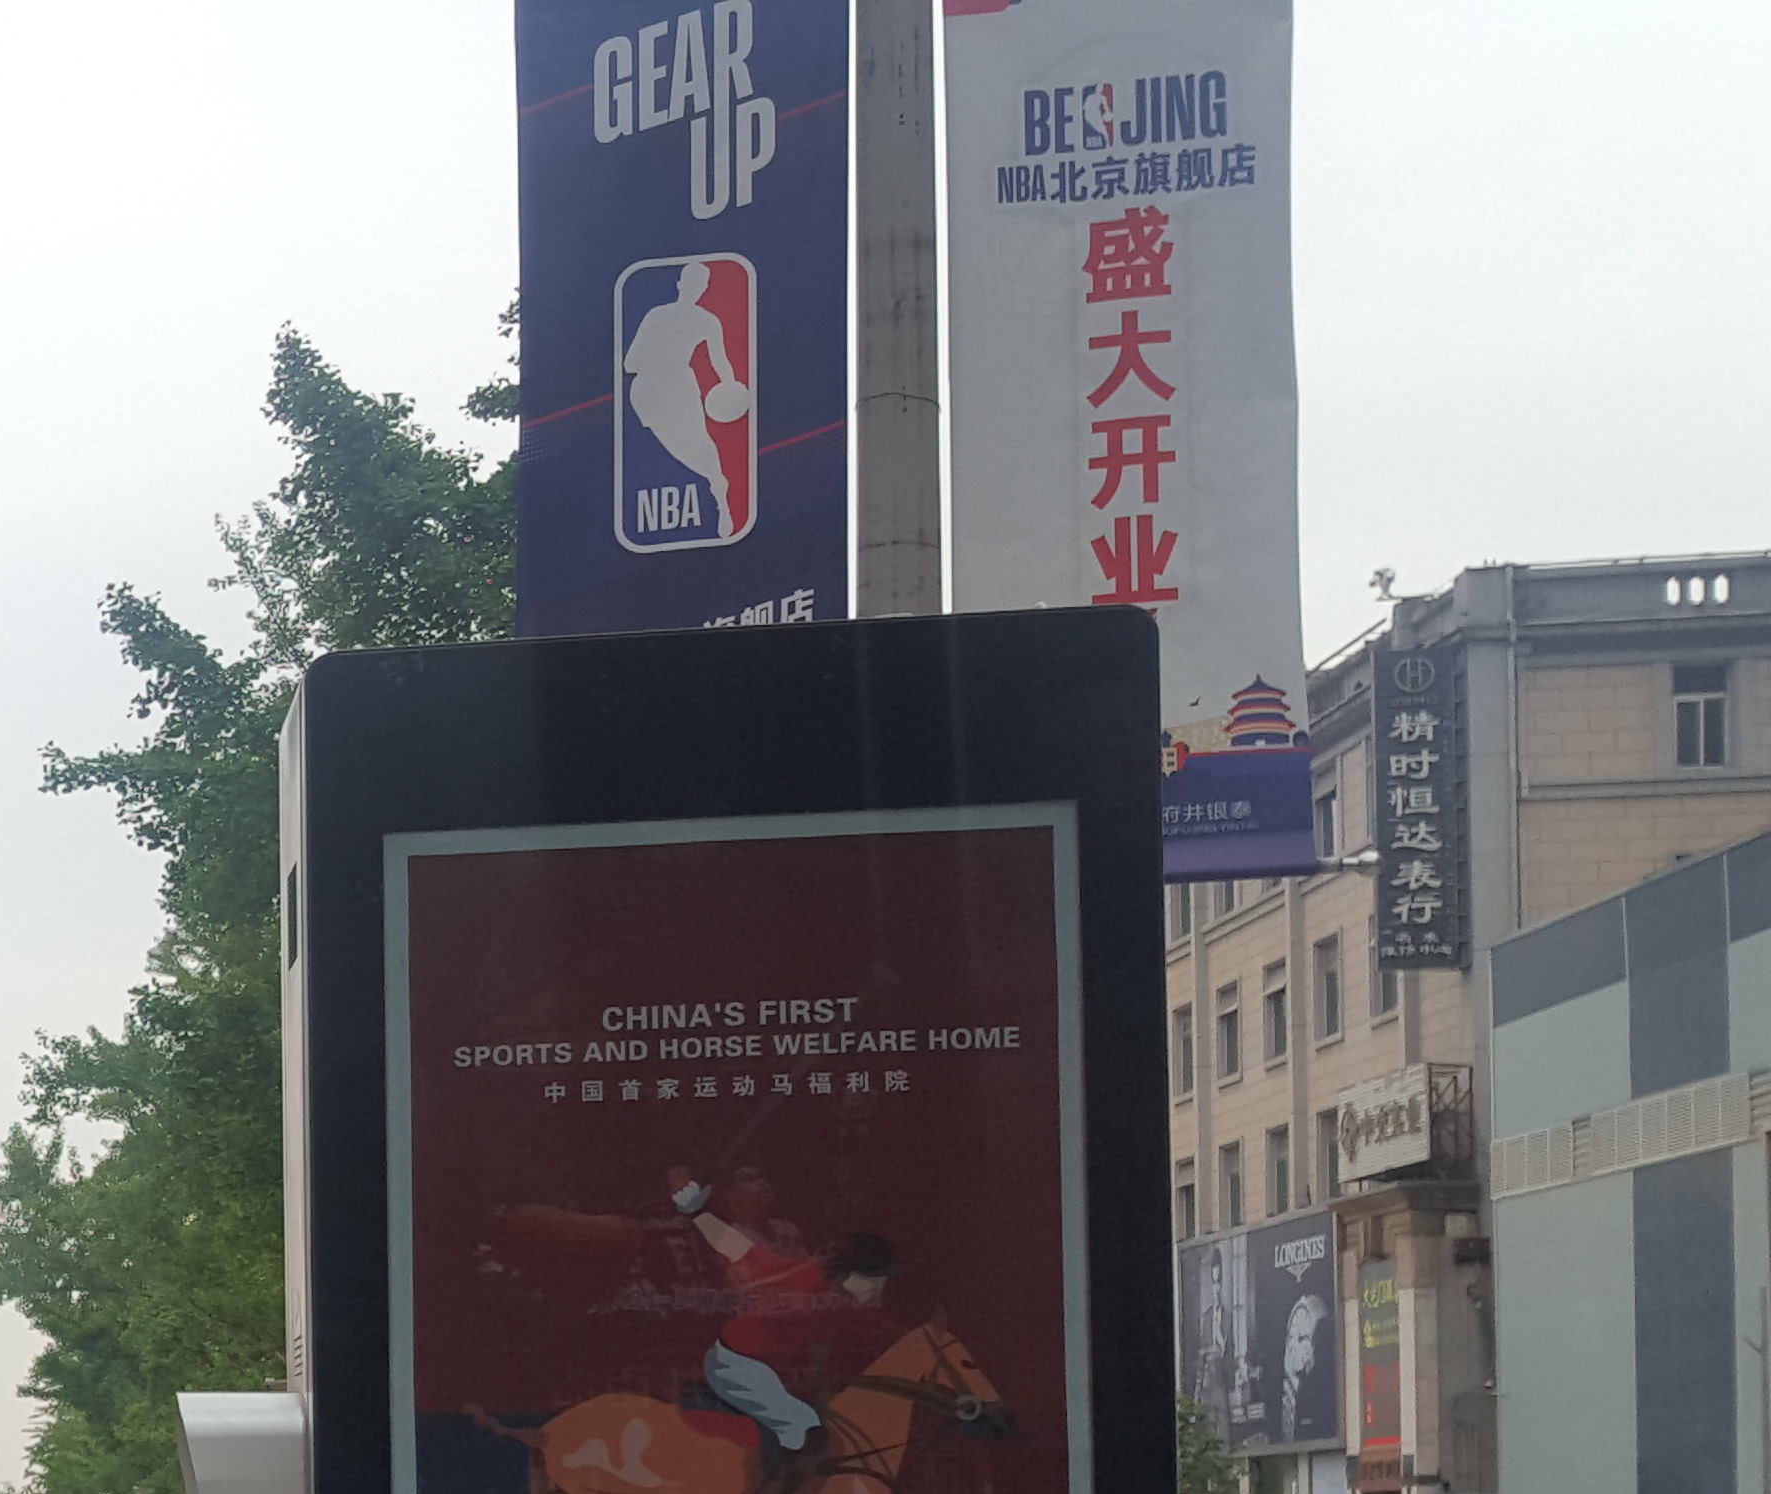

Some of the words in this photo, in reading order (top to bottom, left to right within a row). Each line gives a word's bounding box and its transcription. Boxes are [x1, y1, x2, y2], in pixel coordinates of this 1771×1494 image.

[593, 0, 754, 144] GEAR
[690, 96, 776, 220] UP
[997, 143, 1256, 204] NBA北京旗舰店
[1082, 205, 1178, 604] 盛大开业
[636, 483, 702, 533] NBA
[1388, 711, 1443, 925] 精时恒达表行
[602, 1000, 746, 1033] CHINA'S
[759, 998, 858, 1026] FIRST
[453, 1041, 572, 1068] SPORTS
[583, 1038, 648, 1064] AND
[660, 1035, 761, 1061] HORSE
[772, 1029, 917, 1058] WELFARE
[928, 1026, 1020, 1051] HOME
[543, 1070, 911, 1104] 中国首家运动马福利院
[1274, 1234, 1326, 1268] LONGINES
